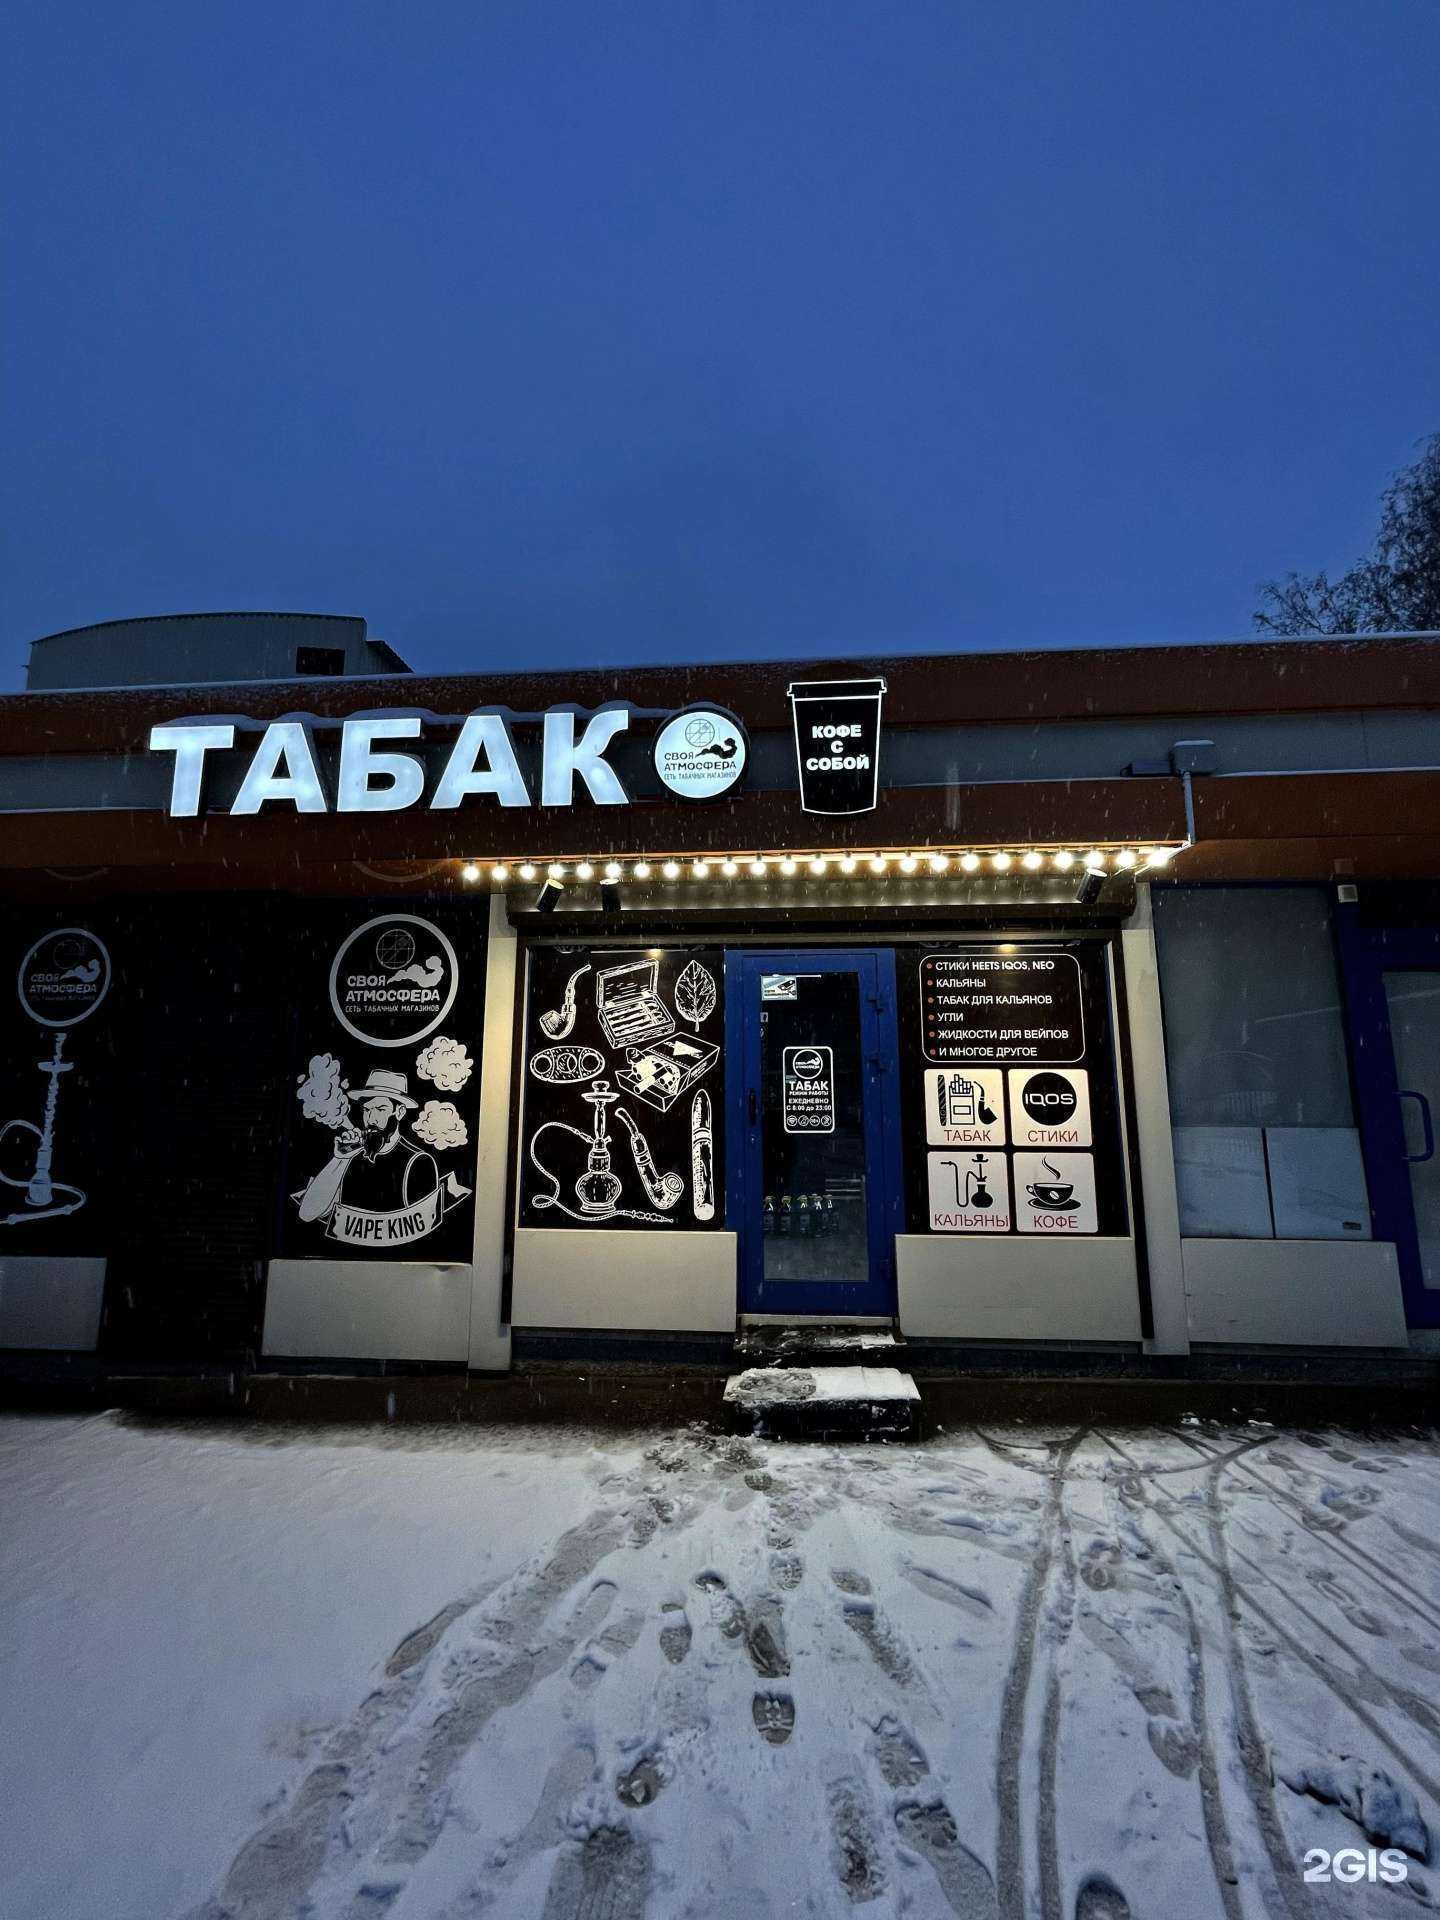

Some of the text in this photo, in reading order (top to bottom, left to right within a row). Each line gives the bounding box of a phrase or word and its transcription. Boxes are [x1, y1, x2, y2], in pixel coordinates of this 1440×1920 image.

[812, 724, 862, 739] КОФЕ
[830, 740, 844, 754] С
[664, 752, 694, 761] СВОЯ
[806, 754, 870, 771] СОБОЙ
[149, 709, 629, 818] ТАБАК
[664, 761, 737, 771] АТМОСФЕРА
[935, 960, 1055, 971] СТИКИ HEETS IQOS, NEO
[347, 975, 386, 987] СВОЯ
[936, 978, 987, 988] КАЛЬЯНЫ
[345, 989, 440, 1003] АТМОСФЕРА
[937, 995, 1053, 1006] ТАБАК ДЛЯ КАЛЬЯНОВ
[345, 1005, 361, 1013] СЕТЬ
[401, 1004, 440, 1012] МАГАЗИНОВ
[937, 1012, 964, 1022] УГЛИ
[938, 1028, 1069, 1040] ЖИДКОСТИ ДЛЯ ВЕЙПОВ
[939, 1047, 1038, 1058] И МНОГОЕ ДРУГОЕ
[789, 1081, 829, 1090] ТАБАК
[1024, 1093, 1074, 1107] IQOS
[943, 1129, 992, 1143] ТАБАК
[1027, 1129, 1079, 1143] СТИКИ
[344, 1211, 426, 1241] VAPE KING
[934, 1213, 1009, 1229] КАЛЬЯНЫ
[1033, 1215, 1078, 1229] КОФЕ
